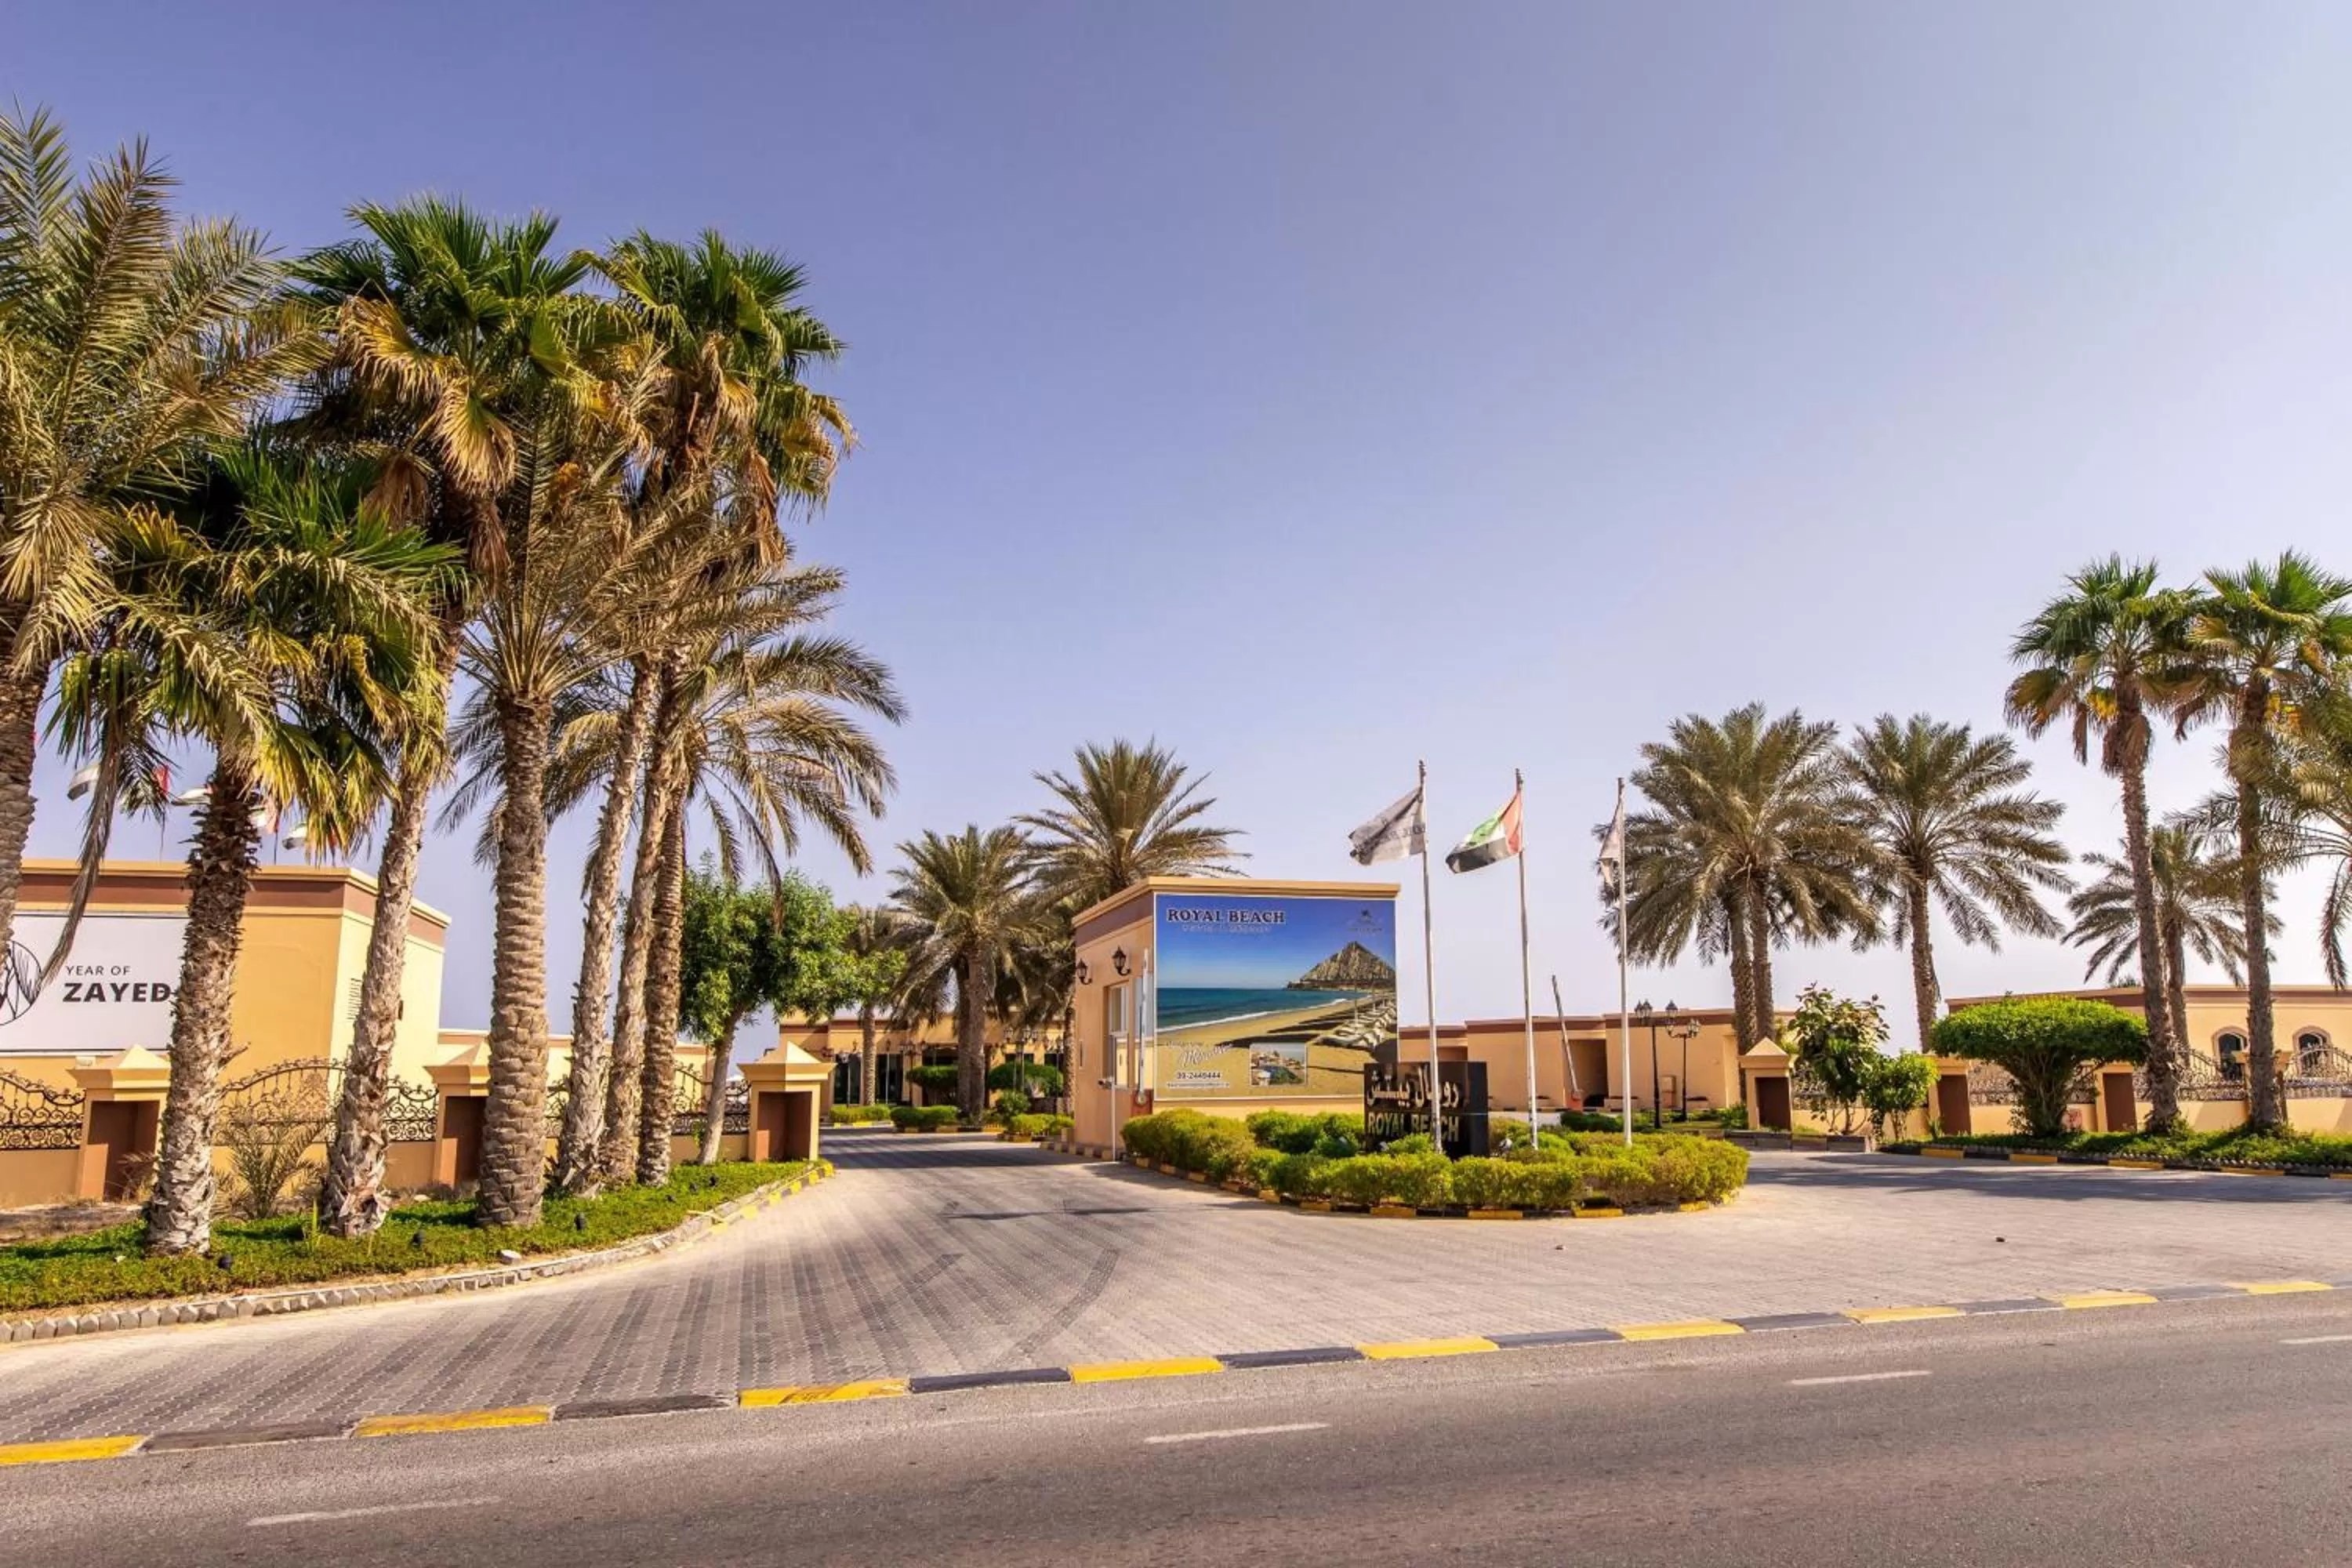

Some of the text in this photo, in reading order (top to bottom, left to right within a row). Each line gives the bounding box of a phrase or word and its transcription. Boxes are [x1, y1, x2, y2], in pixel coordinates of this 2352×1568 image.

[1228, 909, 1286, 924] BEACH
[67, 965, 131, 976] YEAR OF
[63, 982, 171, 1003] ZAYED
[1367, 1112, 1406, 1137] ROYAL
